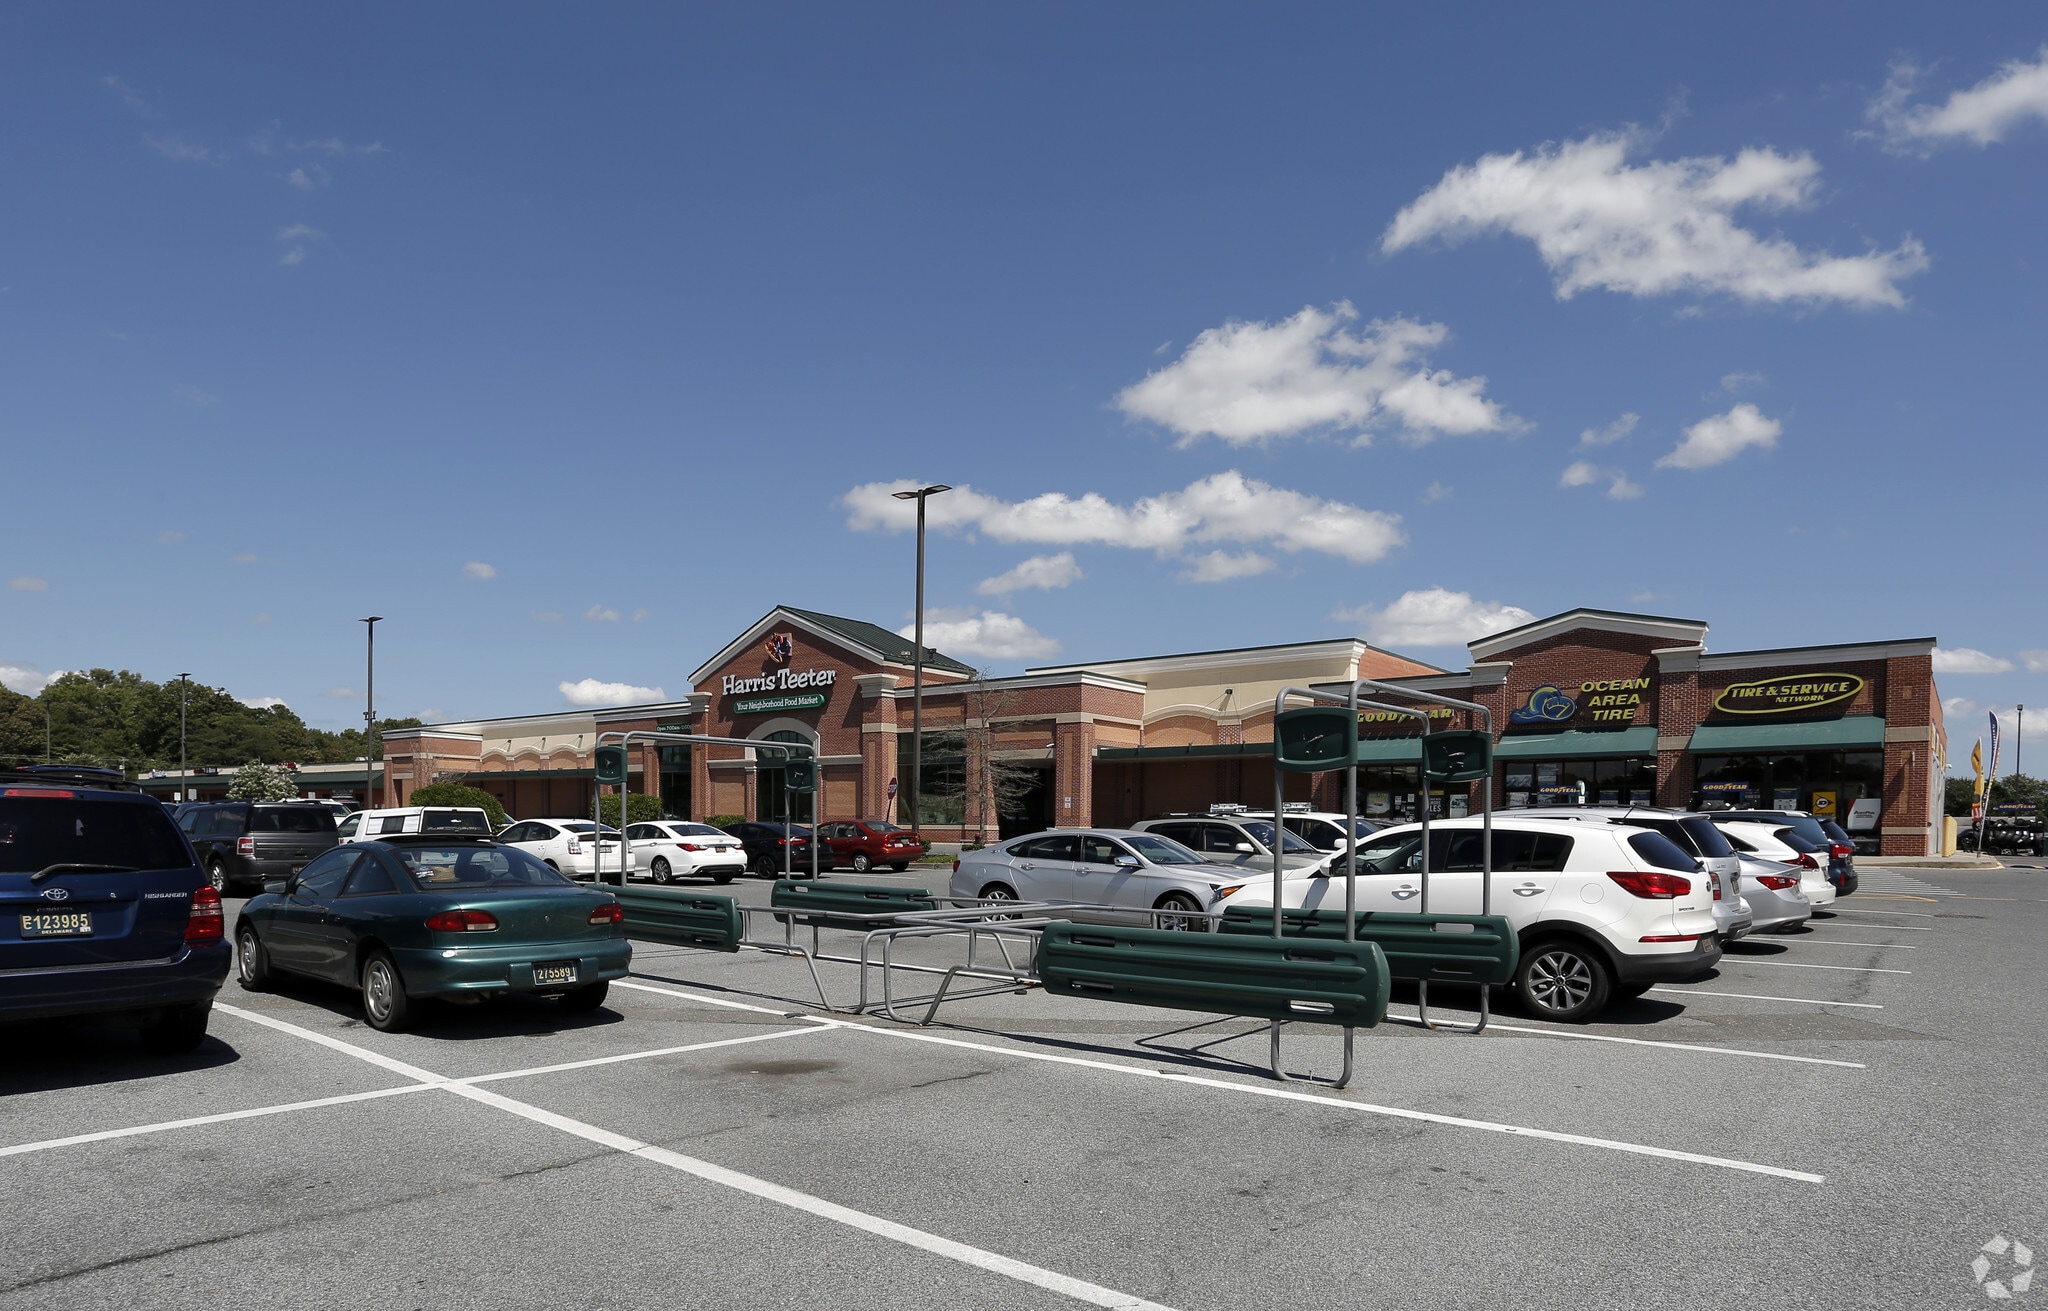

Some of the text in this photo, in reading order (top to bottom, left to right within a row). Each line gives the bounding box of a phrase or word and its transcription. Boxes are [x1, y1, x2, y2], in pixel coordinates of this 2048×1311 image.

[722, 668, 836, 695] Harris Teeter
[1581, 677, 1650, 692] OCEAN
[1731, 682, 1850, 698] TIRE & SERVICE
[737, 696, 818, 711] Your Neighborhood Food Market
[1588, 693, 1640, 707] AREA
[1775, 694, 1825, 703] NETWORK
[1592, 708, 1635, 721] TIRE
[1702, 783, 1748, 791] GOODYEAR
[537, 966, 571, 979] 275589
